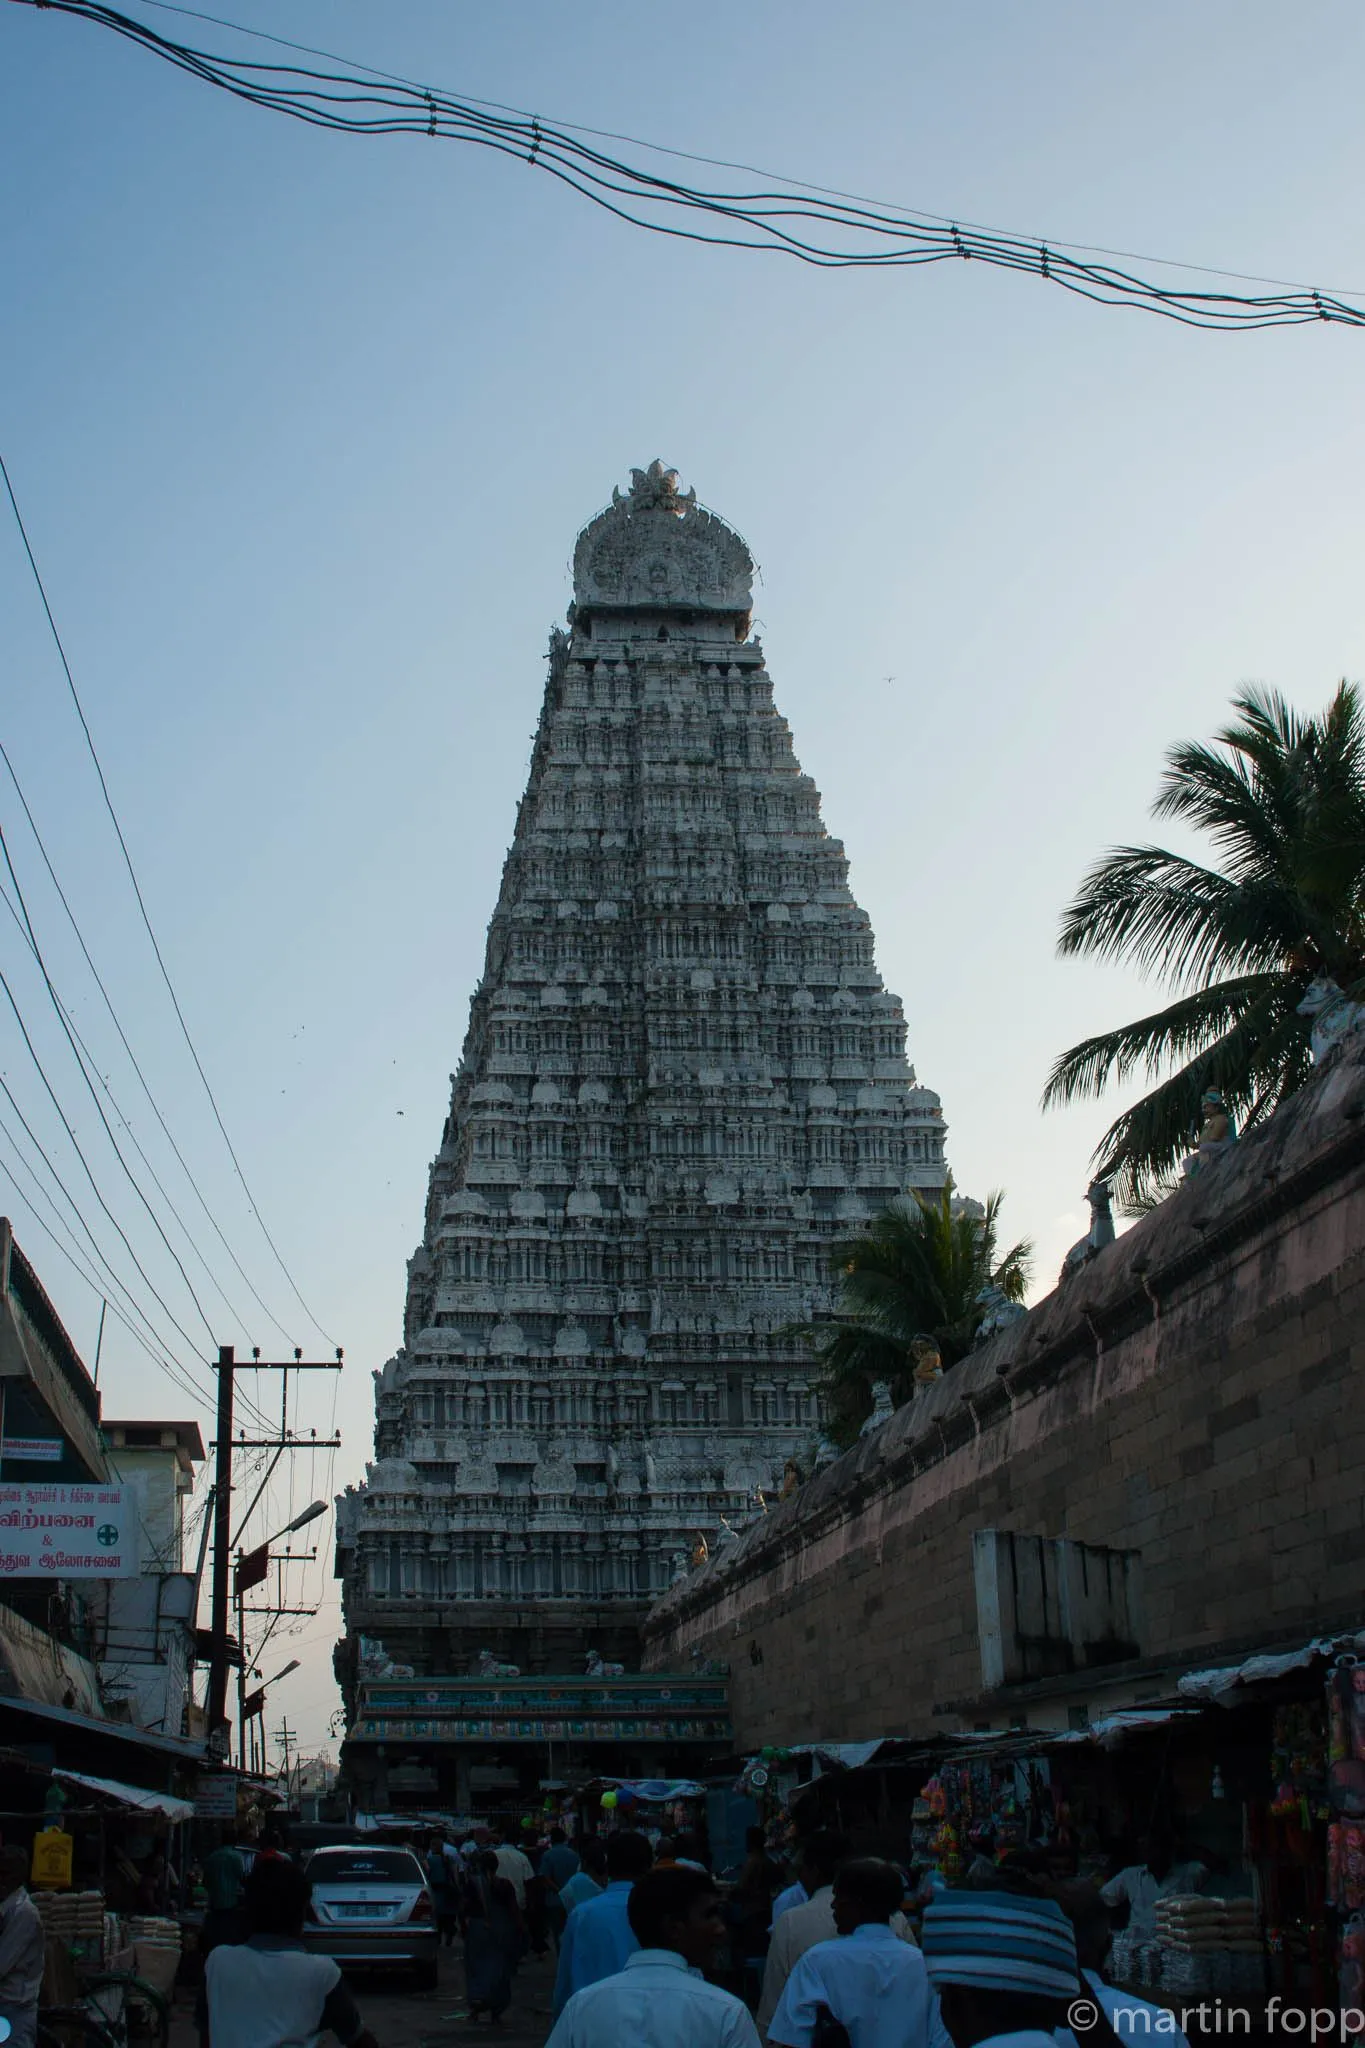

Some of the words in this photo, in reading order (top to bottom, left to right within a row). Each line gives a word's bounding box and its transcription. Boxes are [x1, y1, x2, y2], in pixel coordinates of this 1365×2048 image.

[0, 1508, 97, 1530] விற்பனை
[42, 1534, 53, 1546] &
[39, 1551, 122, 1570] ஆலோசனை
